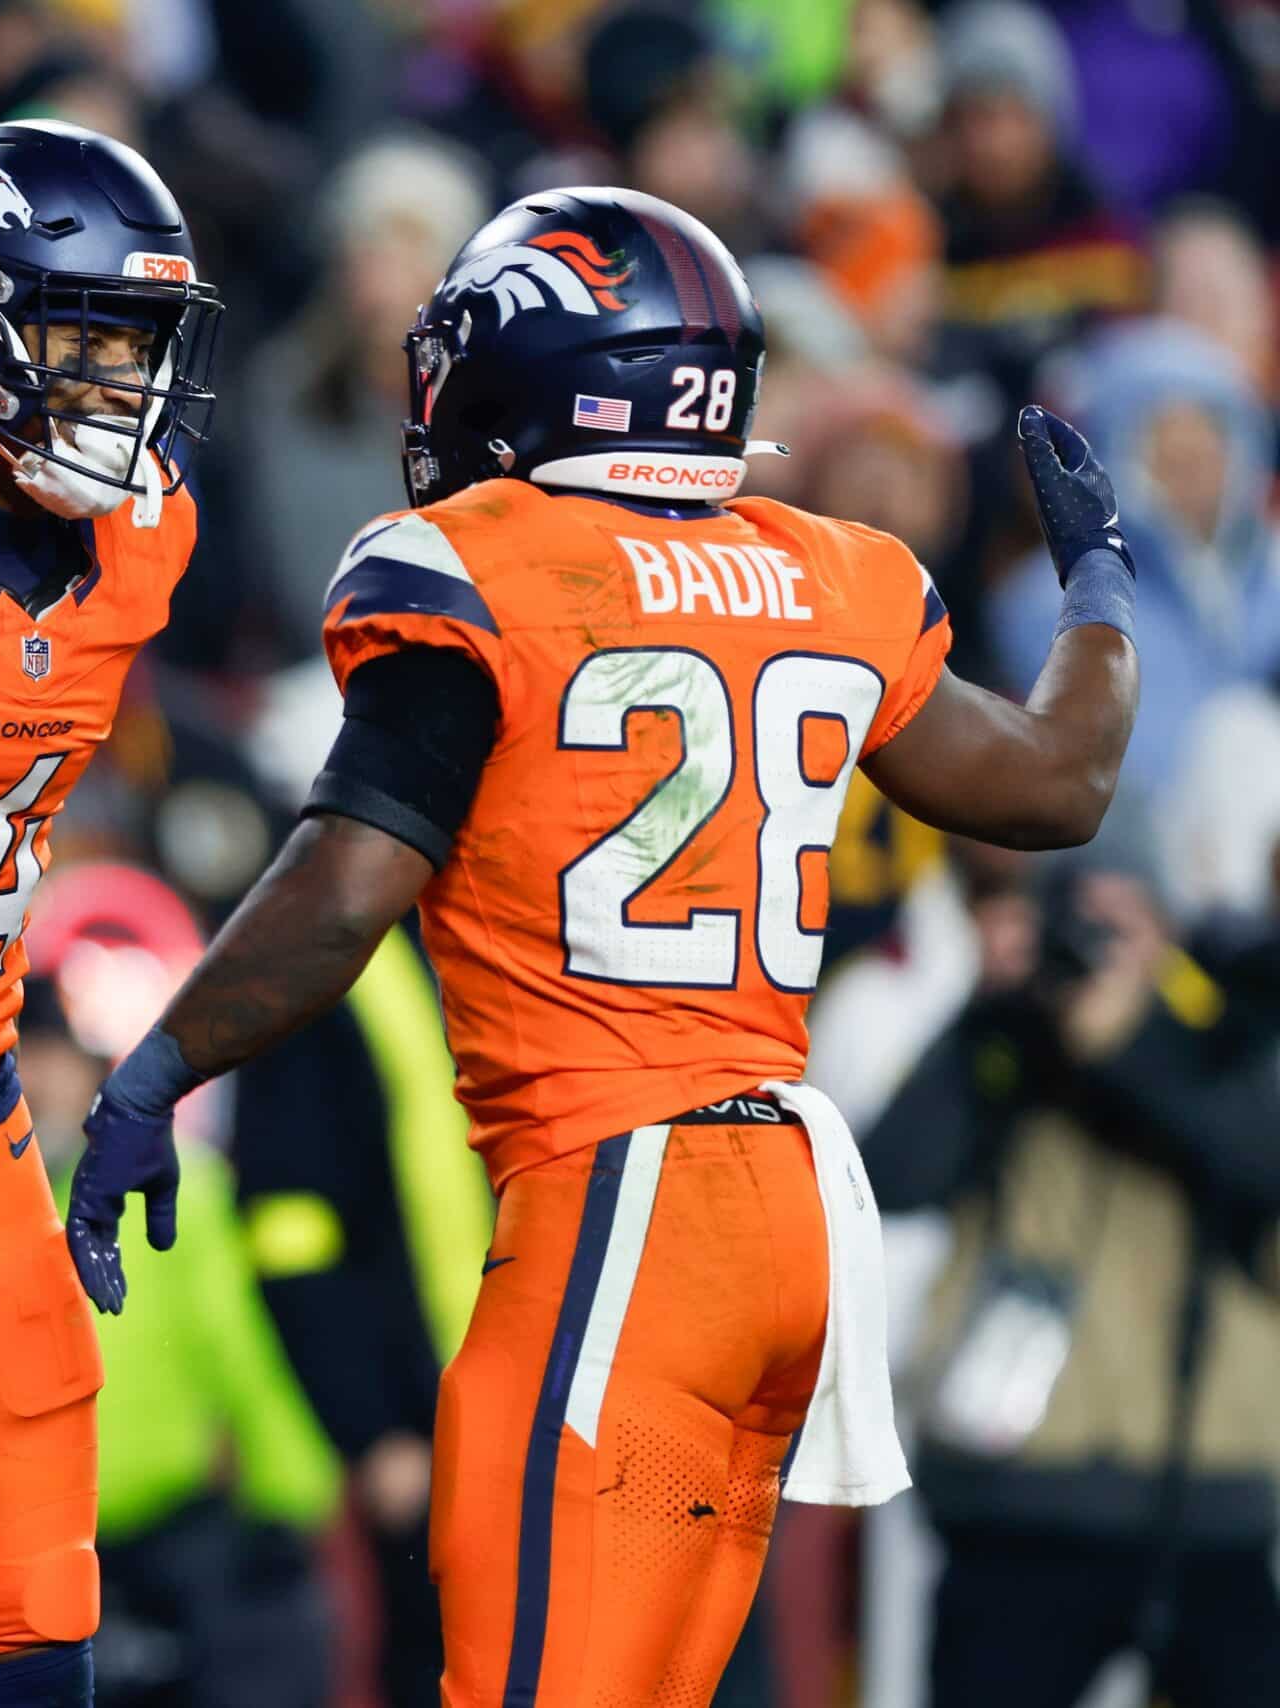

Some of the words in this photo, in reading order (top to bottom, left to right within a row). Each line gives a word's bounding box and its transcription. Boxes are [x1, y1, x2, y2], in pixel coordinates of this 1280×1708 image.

[144, 257, 190, 281] 5280
[665, 366, 737, 431] 28
[608, 463, 739, 487] BRONCOS
[615, 535, 813, 620] BADIE
[556, 645, 887, 994] 28
